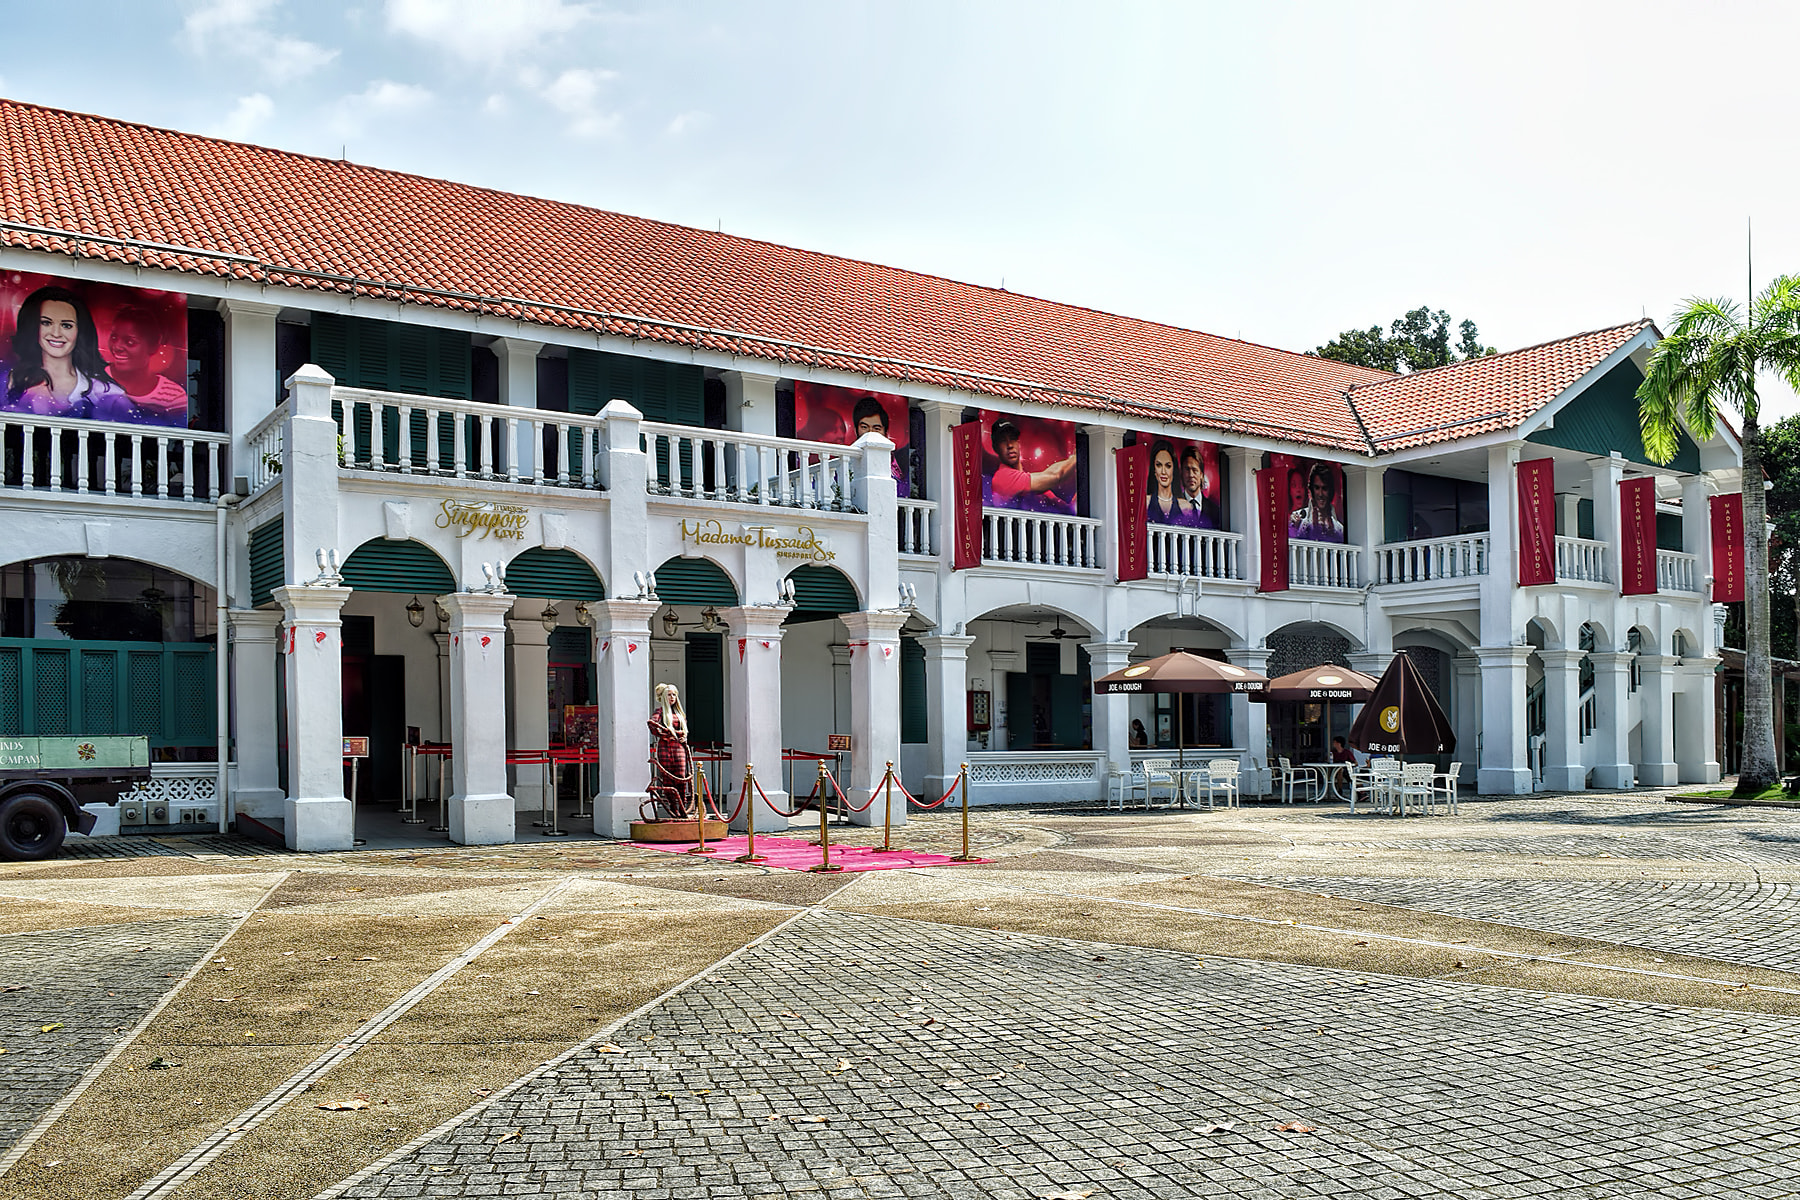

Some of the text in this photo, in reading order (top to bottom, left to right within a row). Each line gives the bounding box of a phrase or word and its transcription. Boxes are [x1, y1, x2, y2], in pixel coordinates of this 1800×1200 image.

[1269, 477, 1277, 520] MADAME
[1532, 469, 1540, 512] MADAME
[435, 498, 529, 539] Singapore
[494, 528, 525, 540] LIVE
[1724, 503, 1732, 541] MADAME
[681, 519, 826, 561] Madame Tussauds
[1123, 683, 1142, 691] DOUGH
[1310, 690, 1322, 698] JOE
[1328, 690, 1352, 698] DOUGH
[1368, 743, 1380, 752] JOE
[1388, 744, 1400, 753] DOU
